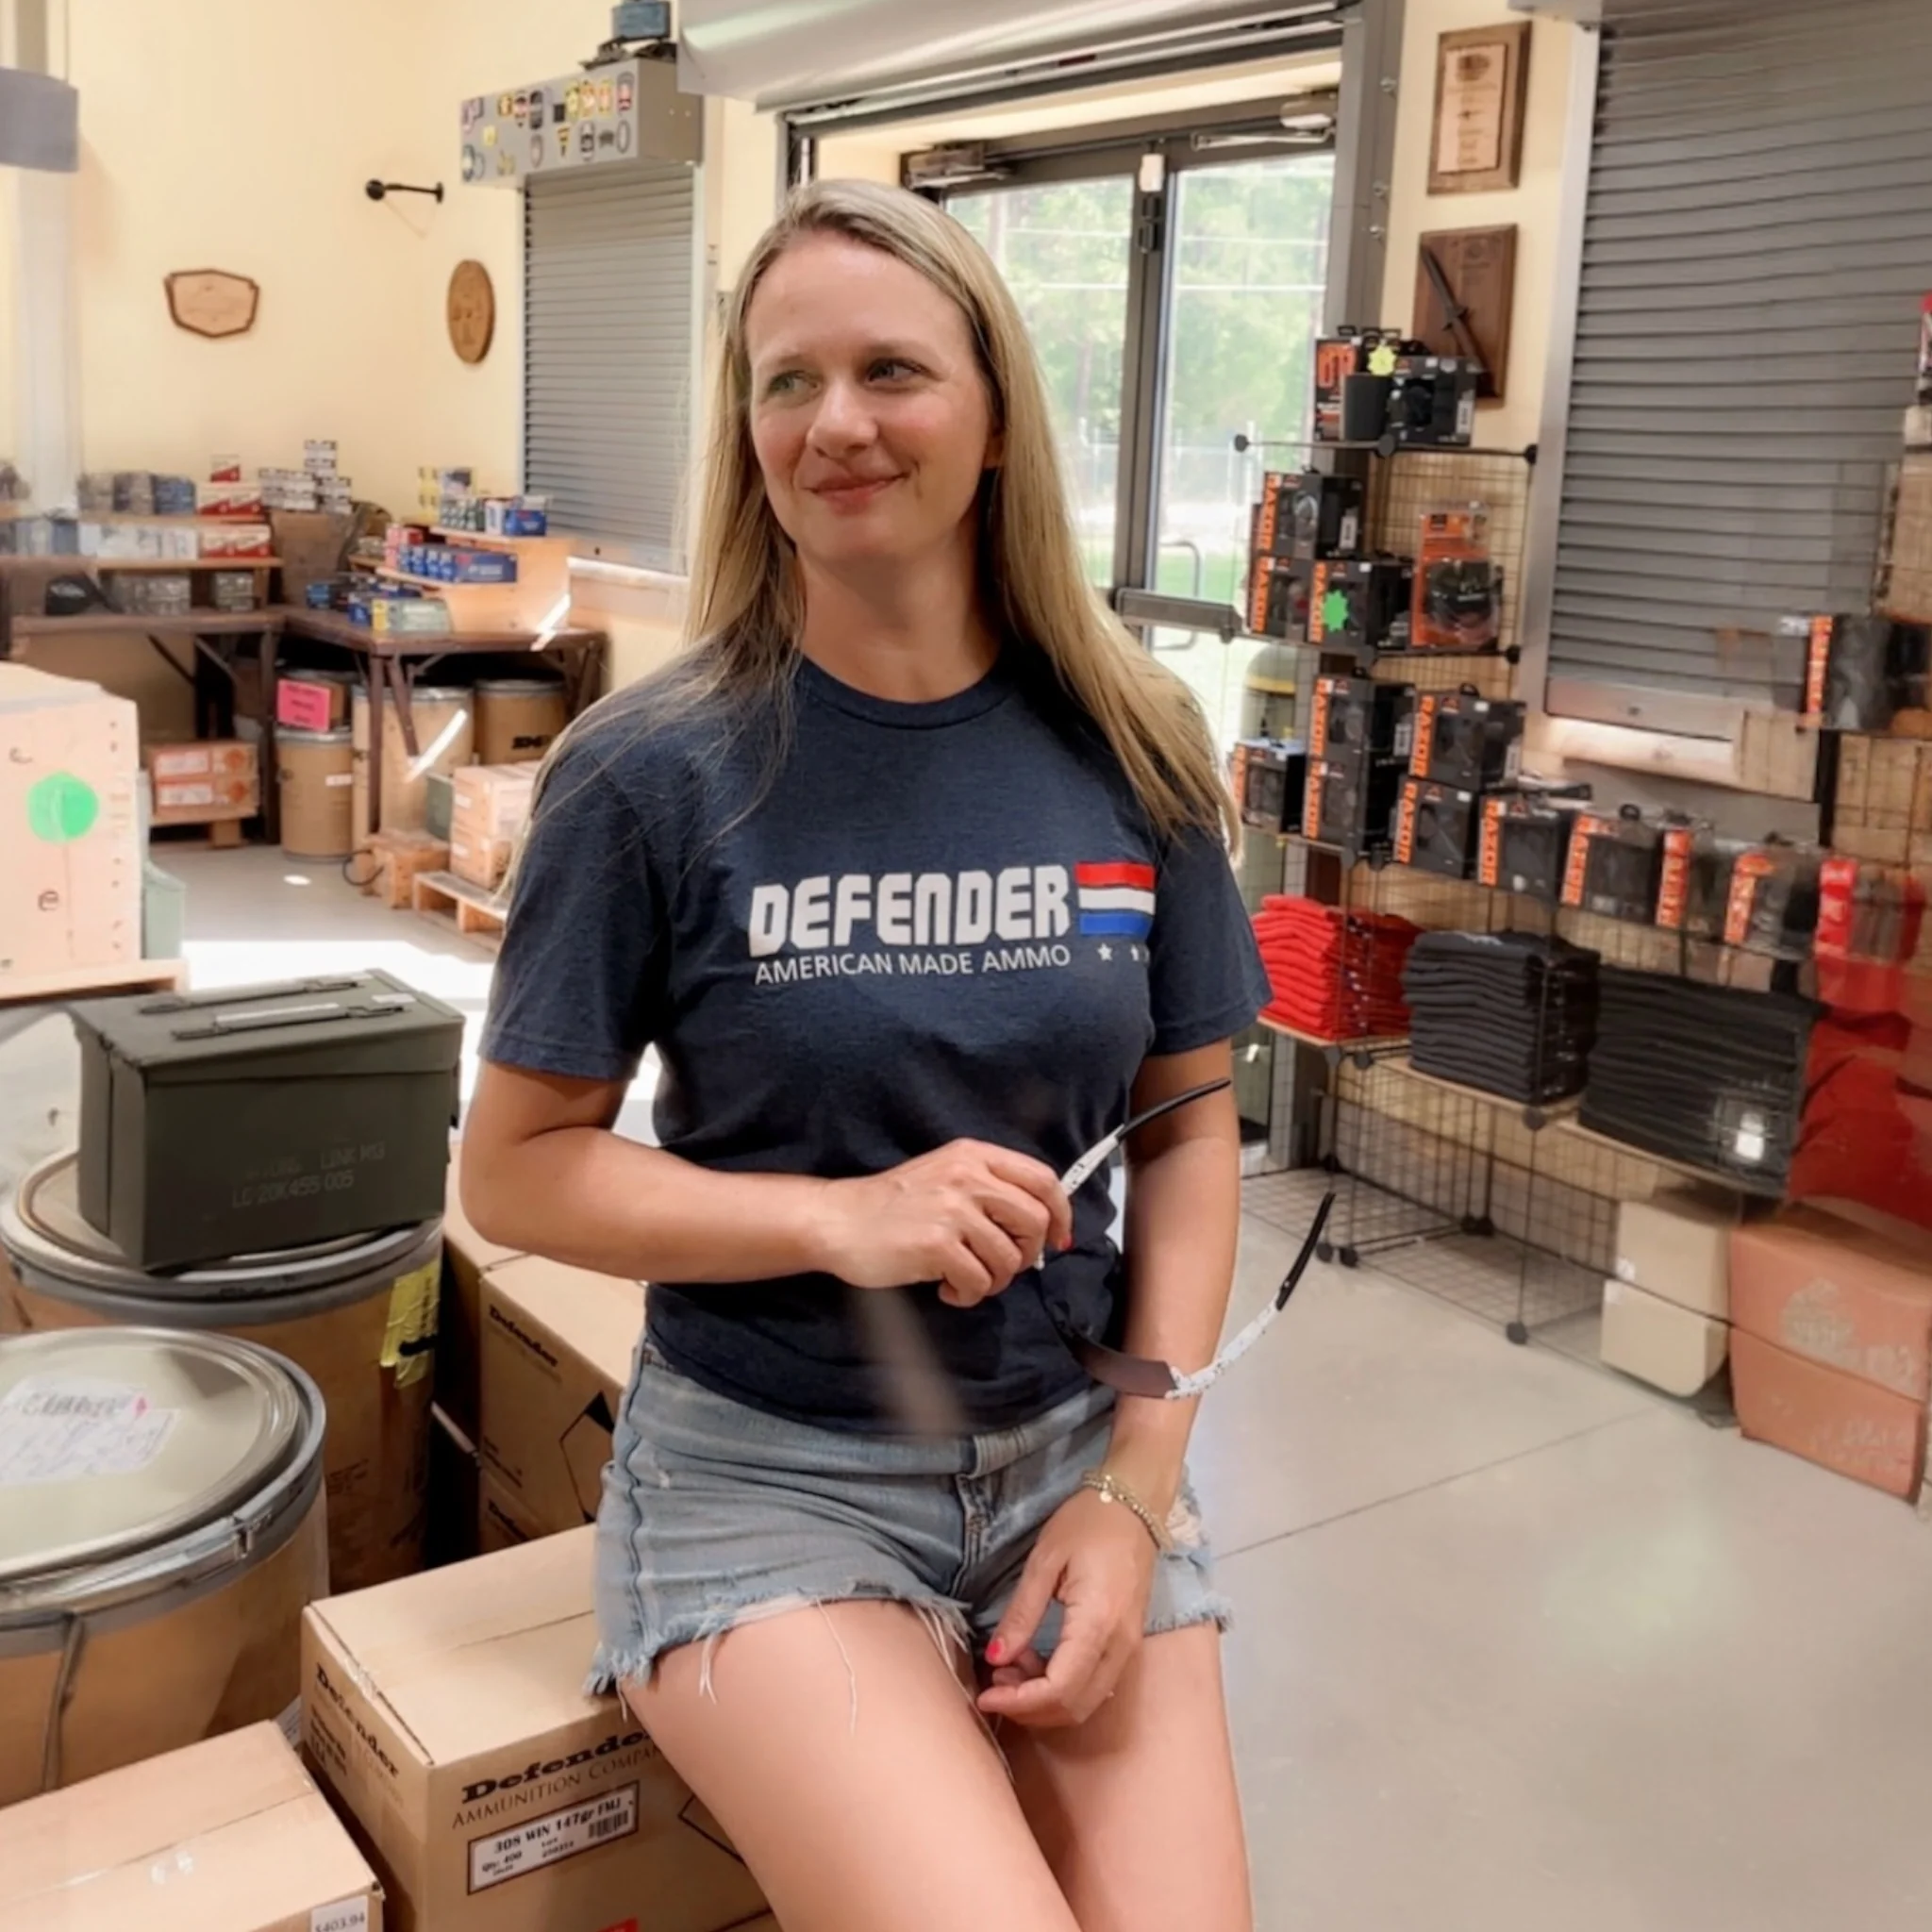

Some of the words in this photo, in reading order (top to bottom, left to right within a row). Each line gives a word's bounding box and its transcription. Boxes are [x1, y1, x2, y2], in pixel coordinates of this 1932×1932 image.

[1412, 694, 1436, 776] RAZOR
[1397, 781, 1419, 863] RAZOR
[749, 864, 1072, 958] DEFENDER
[756, 953, 892, 985] AMERICAN
[900, 952, 974, 974] MADE
[981, 944, 1072, 973] AMMO
[316, 1661, 400, 1779] Defender
[452, 1774, 582, 1830] AMMUNITION
[493, 1836, 522, 1855] 308
[525, 1823, 551, 1843] WIN
[556, 1807, 595, 1833] 147gr
[597, 1796, 622, 1818] FMJ
